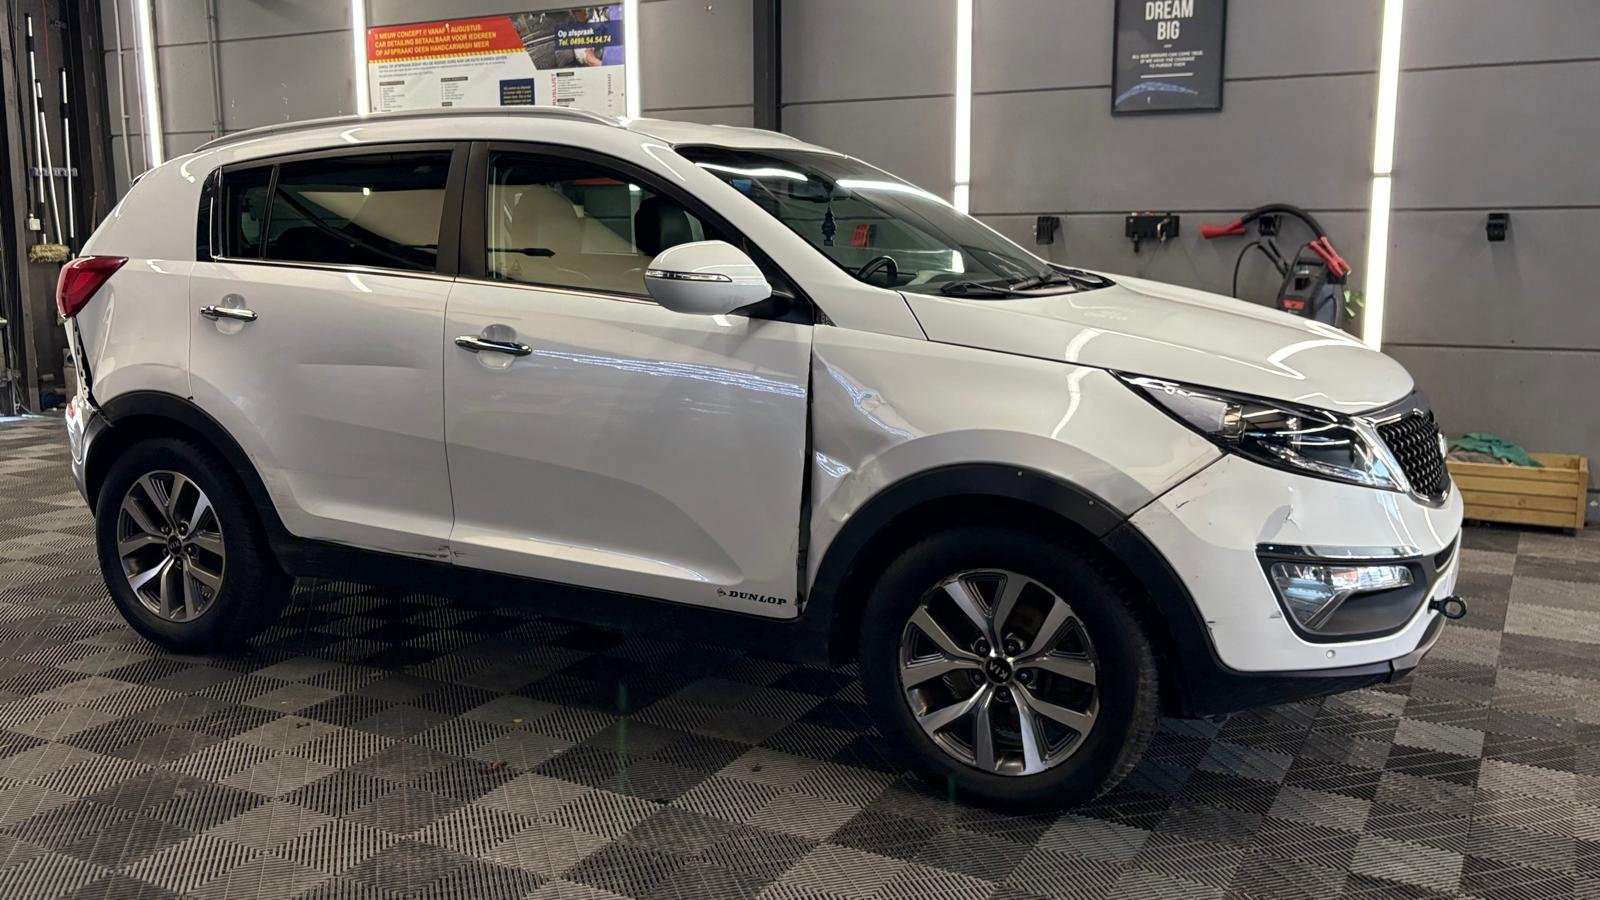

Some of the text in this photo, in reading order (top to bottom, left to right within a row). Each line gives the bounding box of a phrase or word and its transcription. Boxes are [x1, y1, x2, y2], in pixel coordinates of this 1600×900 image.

[1145, 0, 1194, 20] DREAM
[397, 30, 422, 38] CONCEPT
[450, 24, 480, 33] AUGUSTUS
[557, 28, 594, 38] Op afspraak
[1157, 20, 1180, 40] BIG
[374, 32, 497, 48] CAR DETAILING BETAALBAAR VOOR IEDEREEN
[375, 49, 383, 57] OP
[414, 46, 429, 54] GEEN
[430, 42, 473, 52] HANDCARWASH
[473, 40, 490, 49] MEER
[728, 590, 787, 605] DUNLOP
